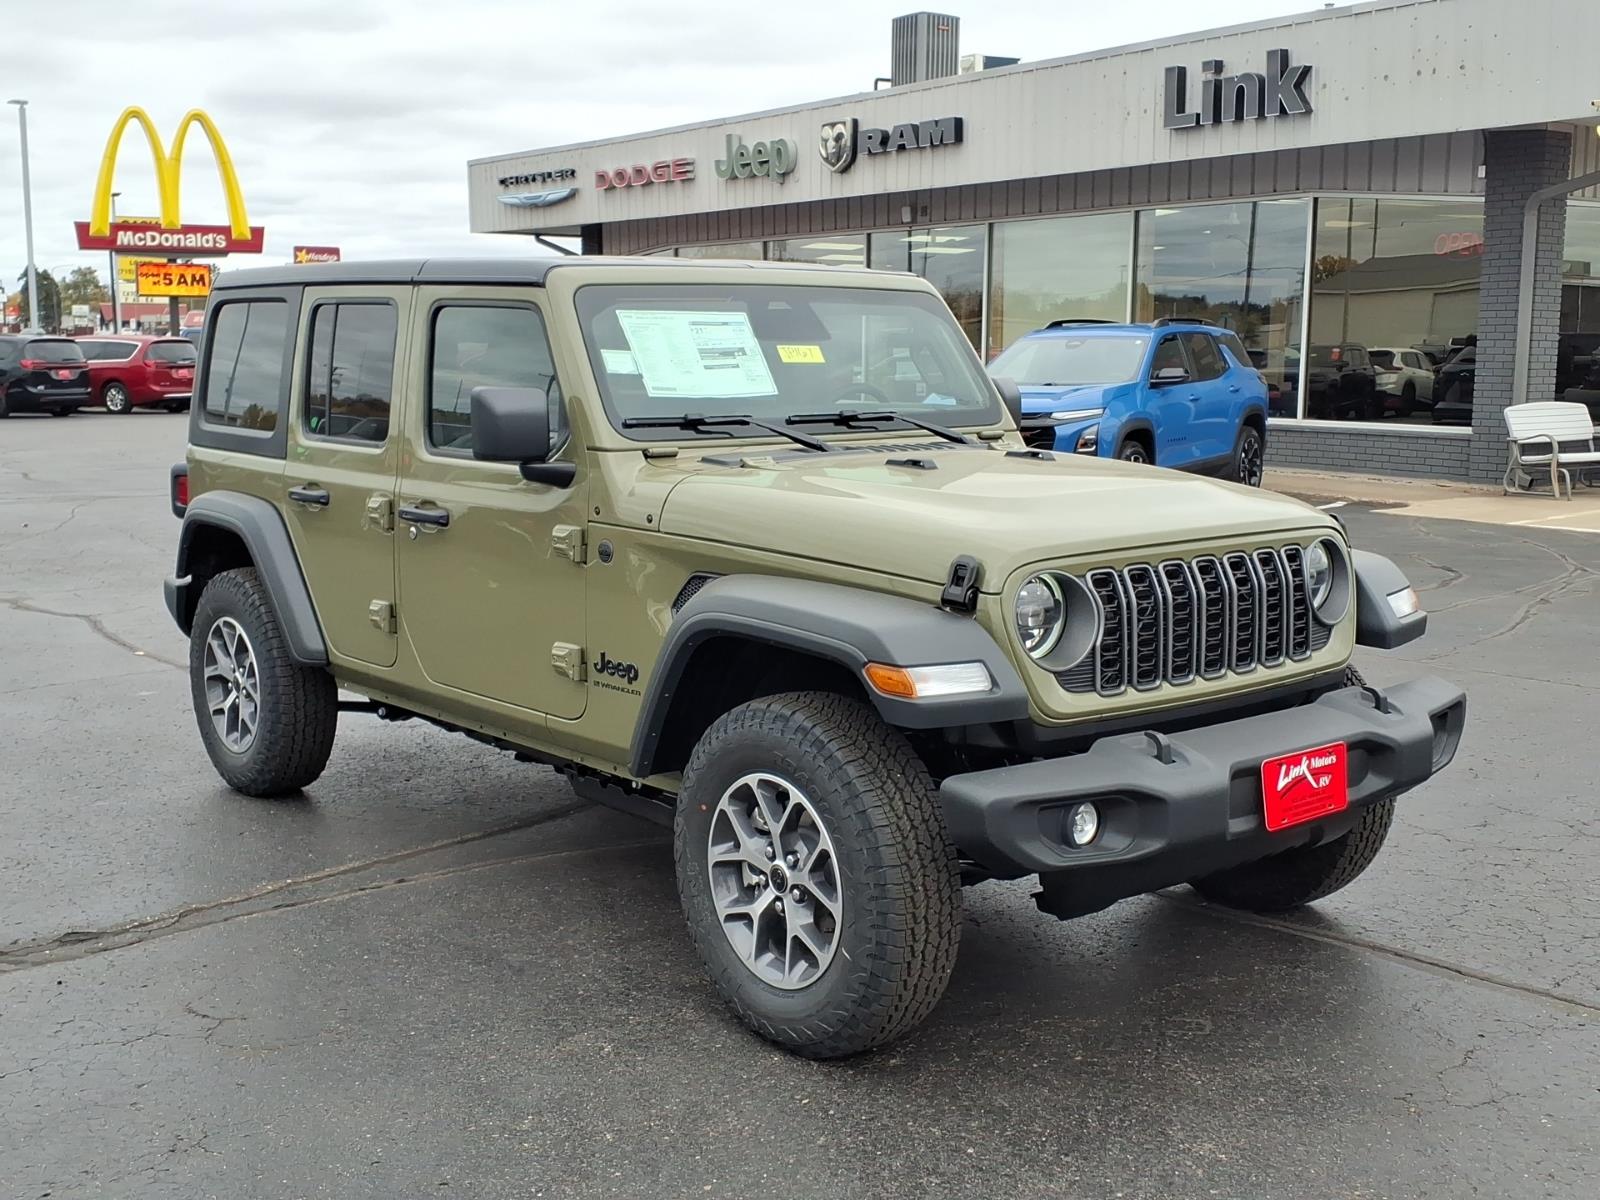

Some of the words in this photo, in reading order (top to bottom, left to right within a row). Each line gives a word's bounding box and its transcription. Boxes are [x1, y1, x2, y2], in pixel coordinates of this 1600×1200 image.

[1164, 48, 1313, 129] Link
[857, 117, 963, 154] RAM
[715, 134, 797, 185] Jeep
[498, 168, 577, 187] CHRYSLER
[595, 158, 695, 190] DODGE
[117, 231, 227, 248] McDonald's
[1433, 232, 1484, 256] OPEN
[163, 272, 174, 287] 5
[176, 272, 207, 287] AM
[593, 651, 639, 685] Jeep
[601, 682, 641, 696] WRANGLER
[1277, 755, 1319, 792] Link
[1310, 754, 1337, 769] Motors
[1318, 774, 1333, 788] RV
